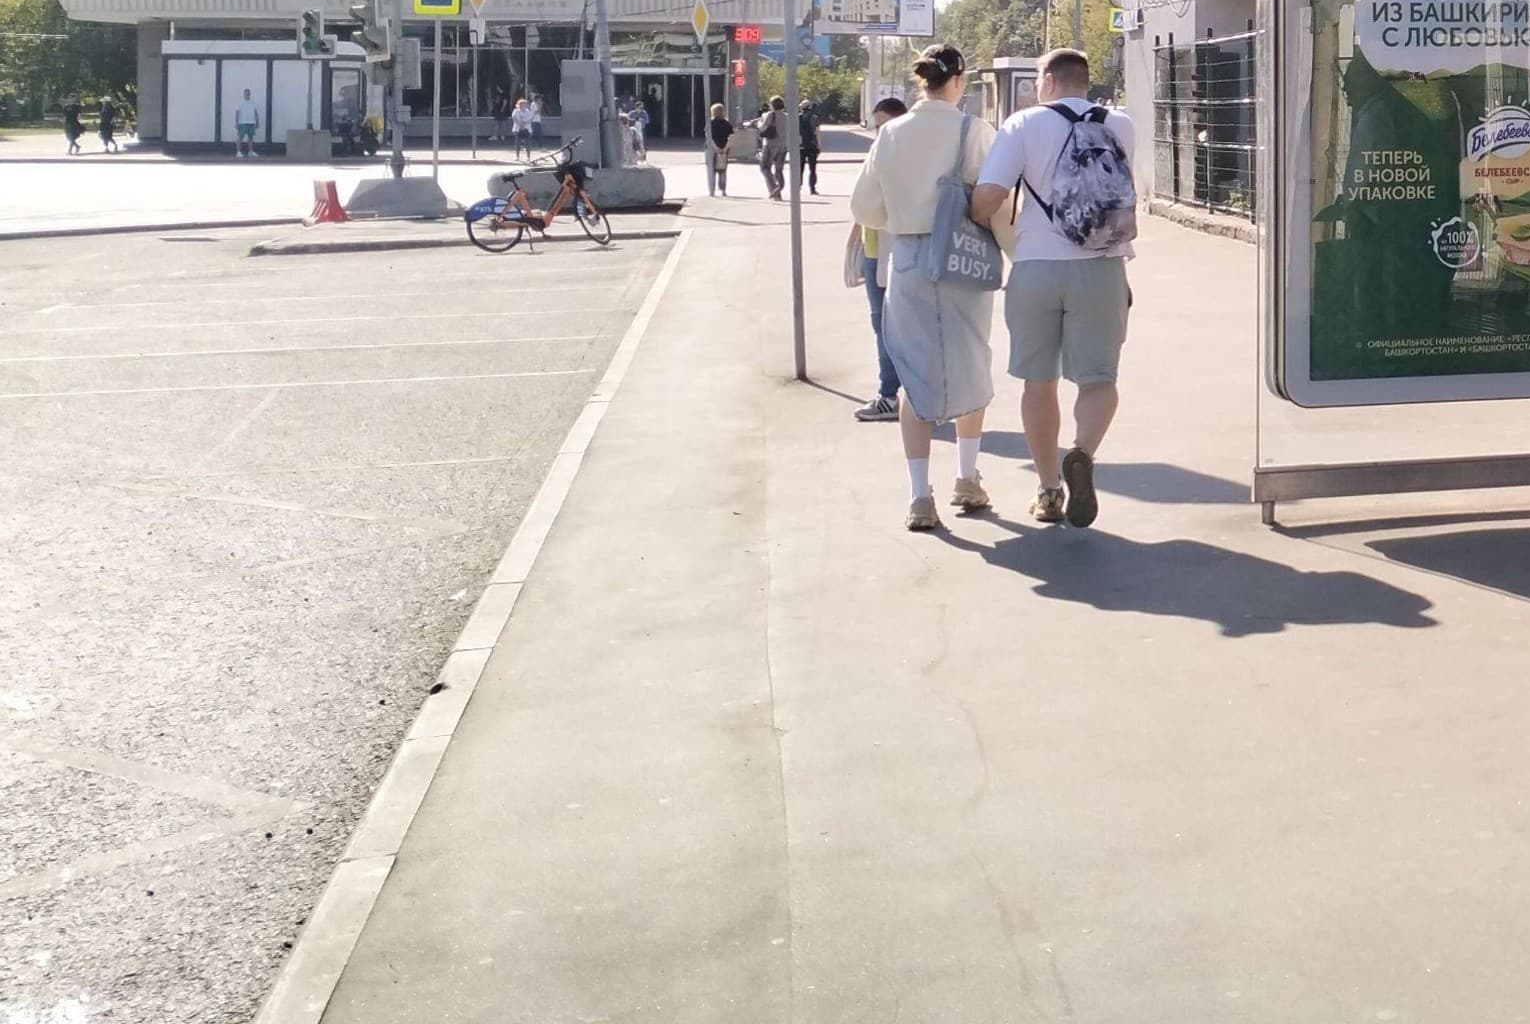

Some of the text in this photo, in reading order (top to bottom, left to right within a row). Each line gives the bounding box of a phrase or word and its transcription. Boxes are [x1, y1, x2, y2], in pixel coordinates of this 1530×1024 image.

[1372, 1, 1402, 23] ИЗ
[1382, 26, 1399, 48] С
[1360, 150, 1423, 165] ТЕПЕРЬ
[1354, 165, 1431, 183] В НОВОЙ
[1348, 185, 1437, 200] УПАКОВКЕ
[952, 231, 987, 257] VERY
[947, 253, 993, 281] BUSY.
